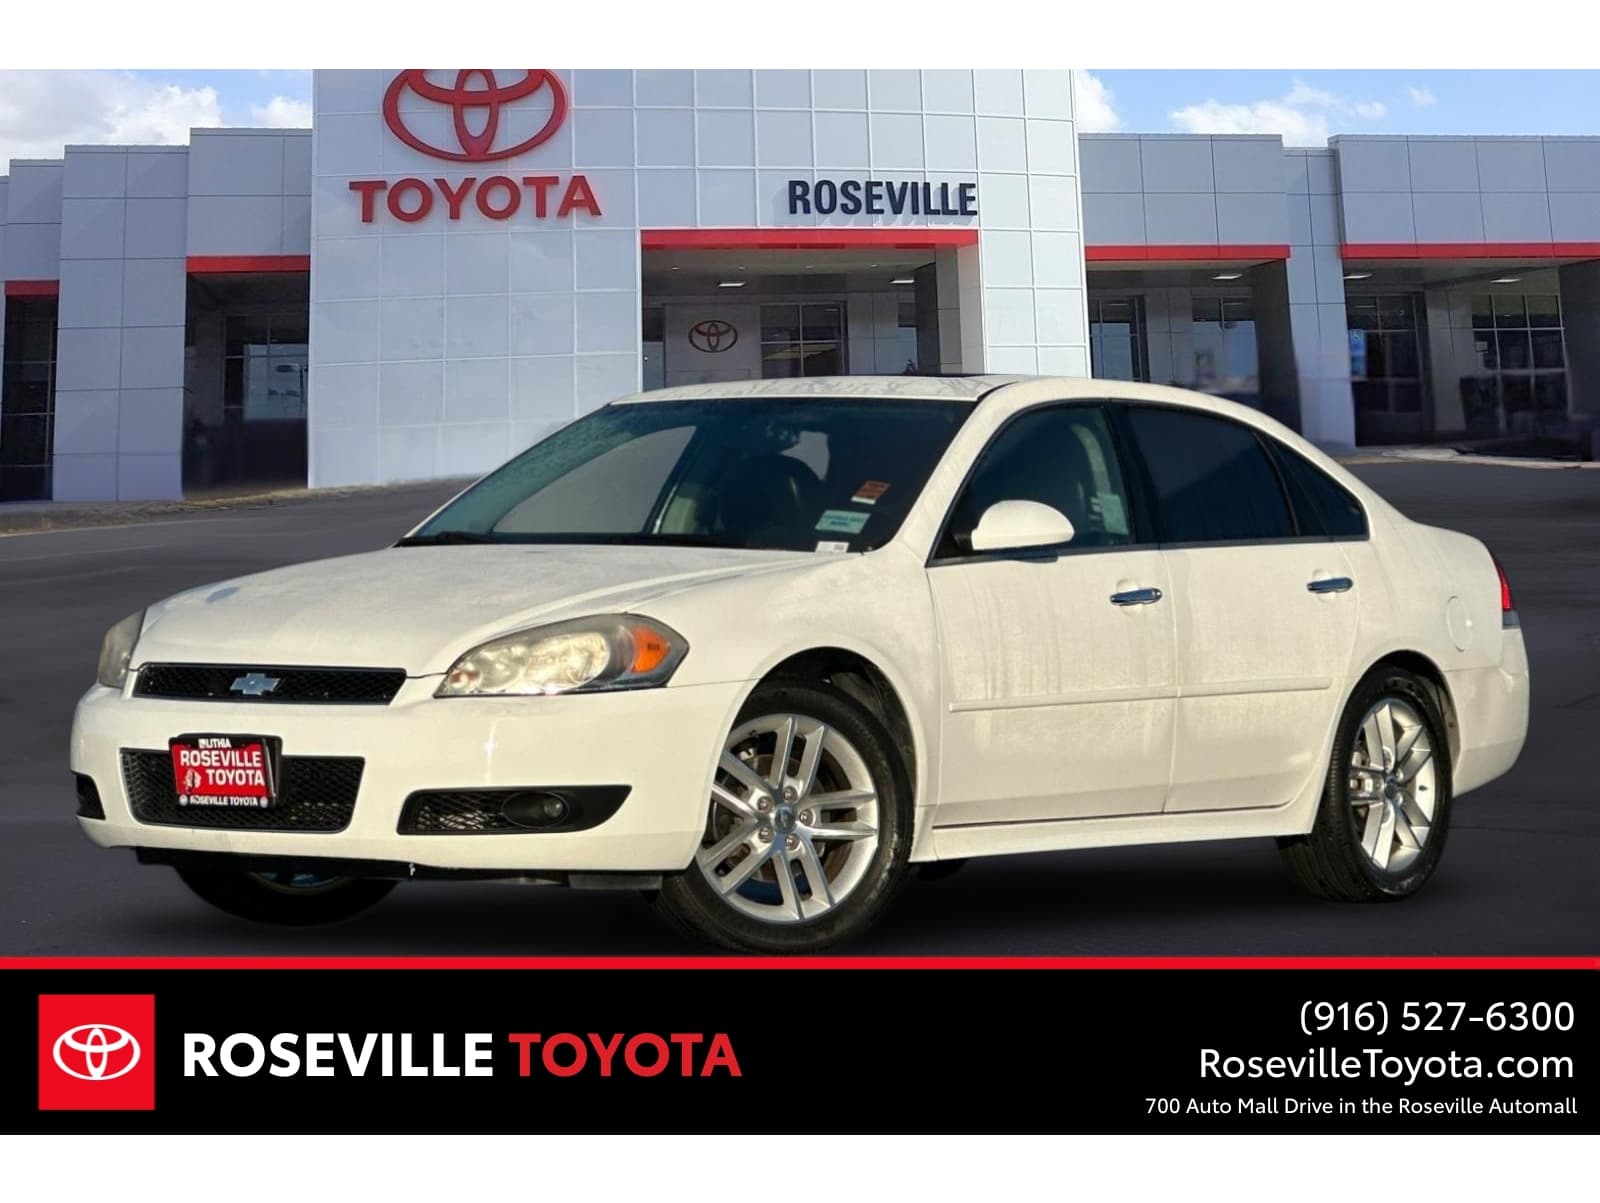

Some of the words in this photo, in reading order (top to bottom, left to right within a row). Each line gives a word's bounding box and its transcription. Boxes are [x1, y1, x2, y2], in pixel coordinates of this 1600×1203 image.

[349, 175, 602, 224] TOYOTA
[788, 179, 979, 217] ROSEVILLE
[206, 738, 232, 749] LITHIA
[180, 750, 262, 767] ROSEVILLE
[205, 769, 265, 787] TOYOTA
[190, 795, 228, 806] ROSEVILLE
[230, 796, 258, 806] TOYOTA
